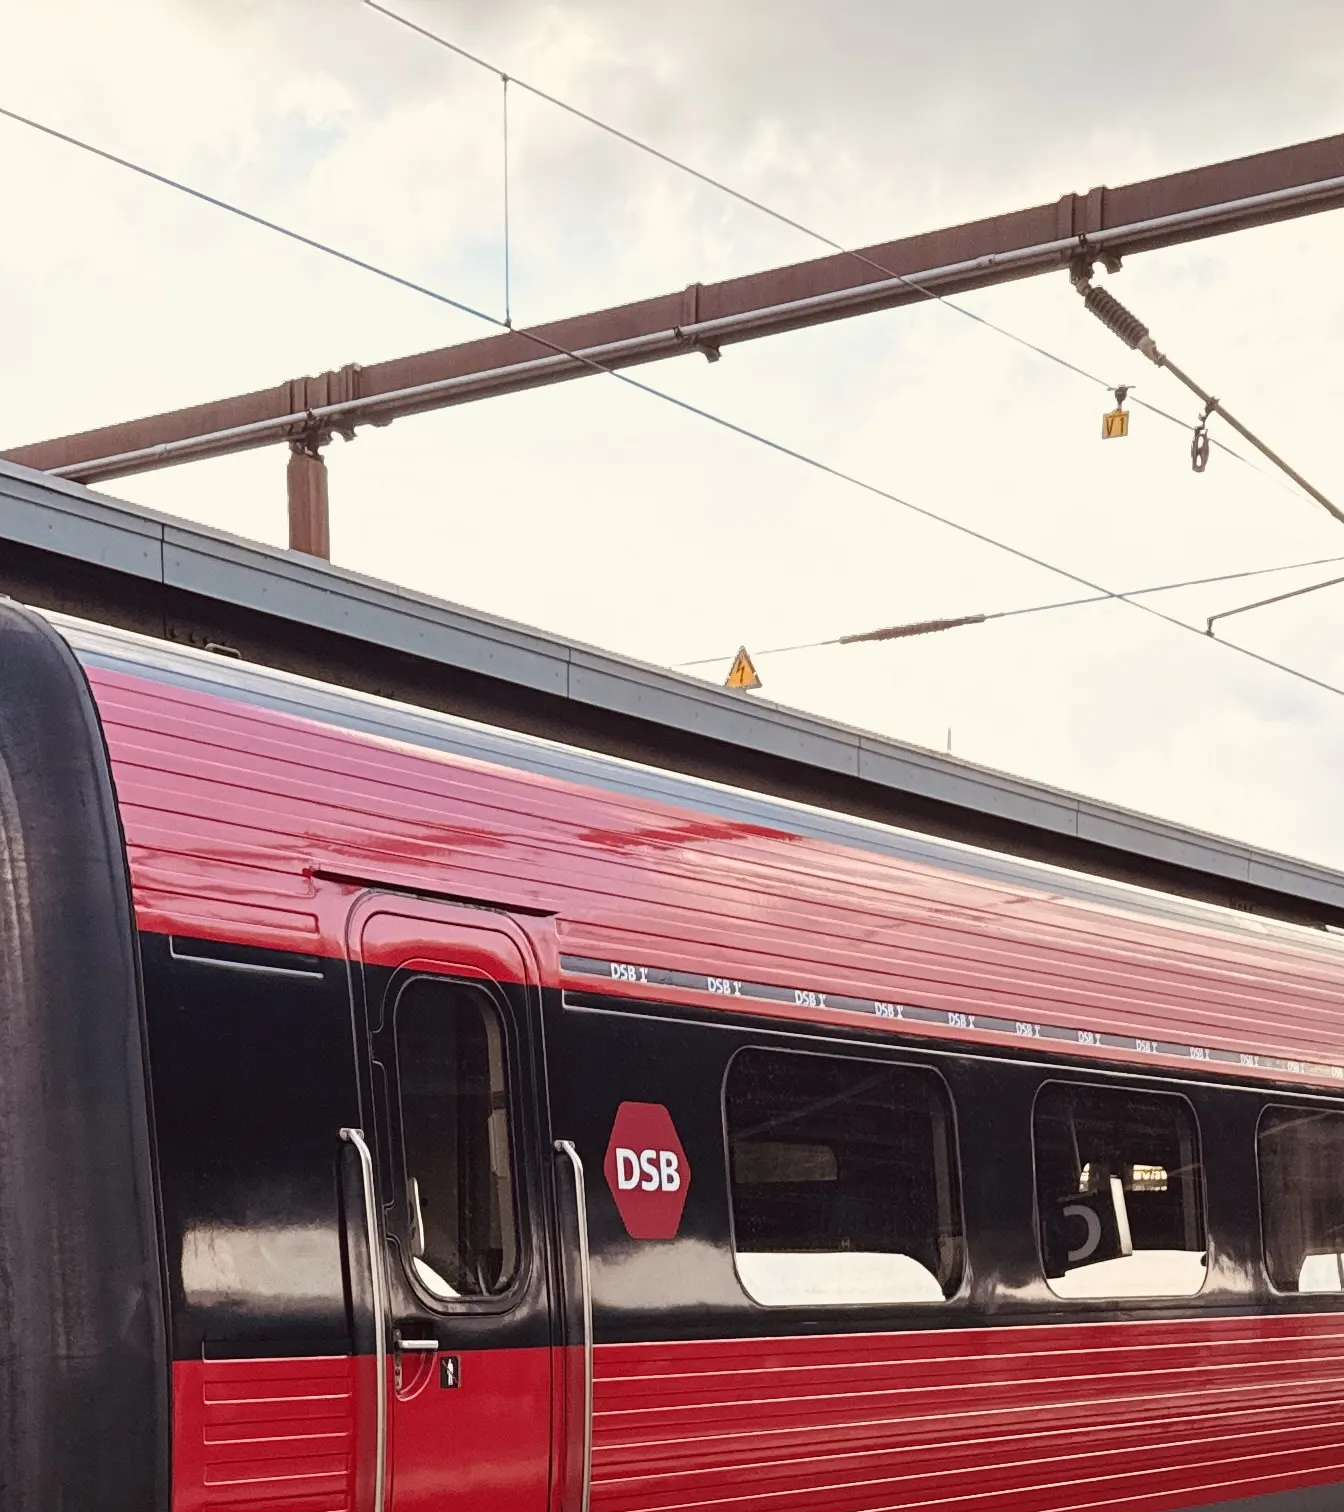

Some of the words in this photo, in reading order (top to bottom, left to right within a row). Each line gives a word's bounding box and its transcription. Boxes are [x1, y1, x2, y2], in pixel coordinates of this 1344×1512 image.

[610, 963, 637, 982] DSB
[707, 977, 731, 995] DSB
[794, 989, 816, 1007] DSB
[874, 1001, 894, 1018] DSB
[947, 1012, 966, 1028] DSB
[1015, 1021, 1033, 1037] DSB
[1077, 1031, 1094, 1045] DSB
[1135, 1039, 1150, 1052] DSB
[1189, 1047, 1204, 1060] DSB
[1240, 1053, 1253, 1066] DSB
[615, 1147, 681, 1192] DSB
